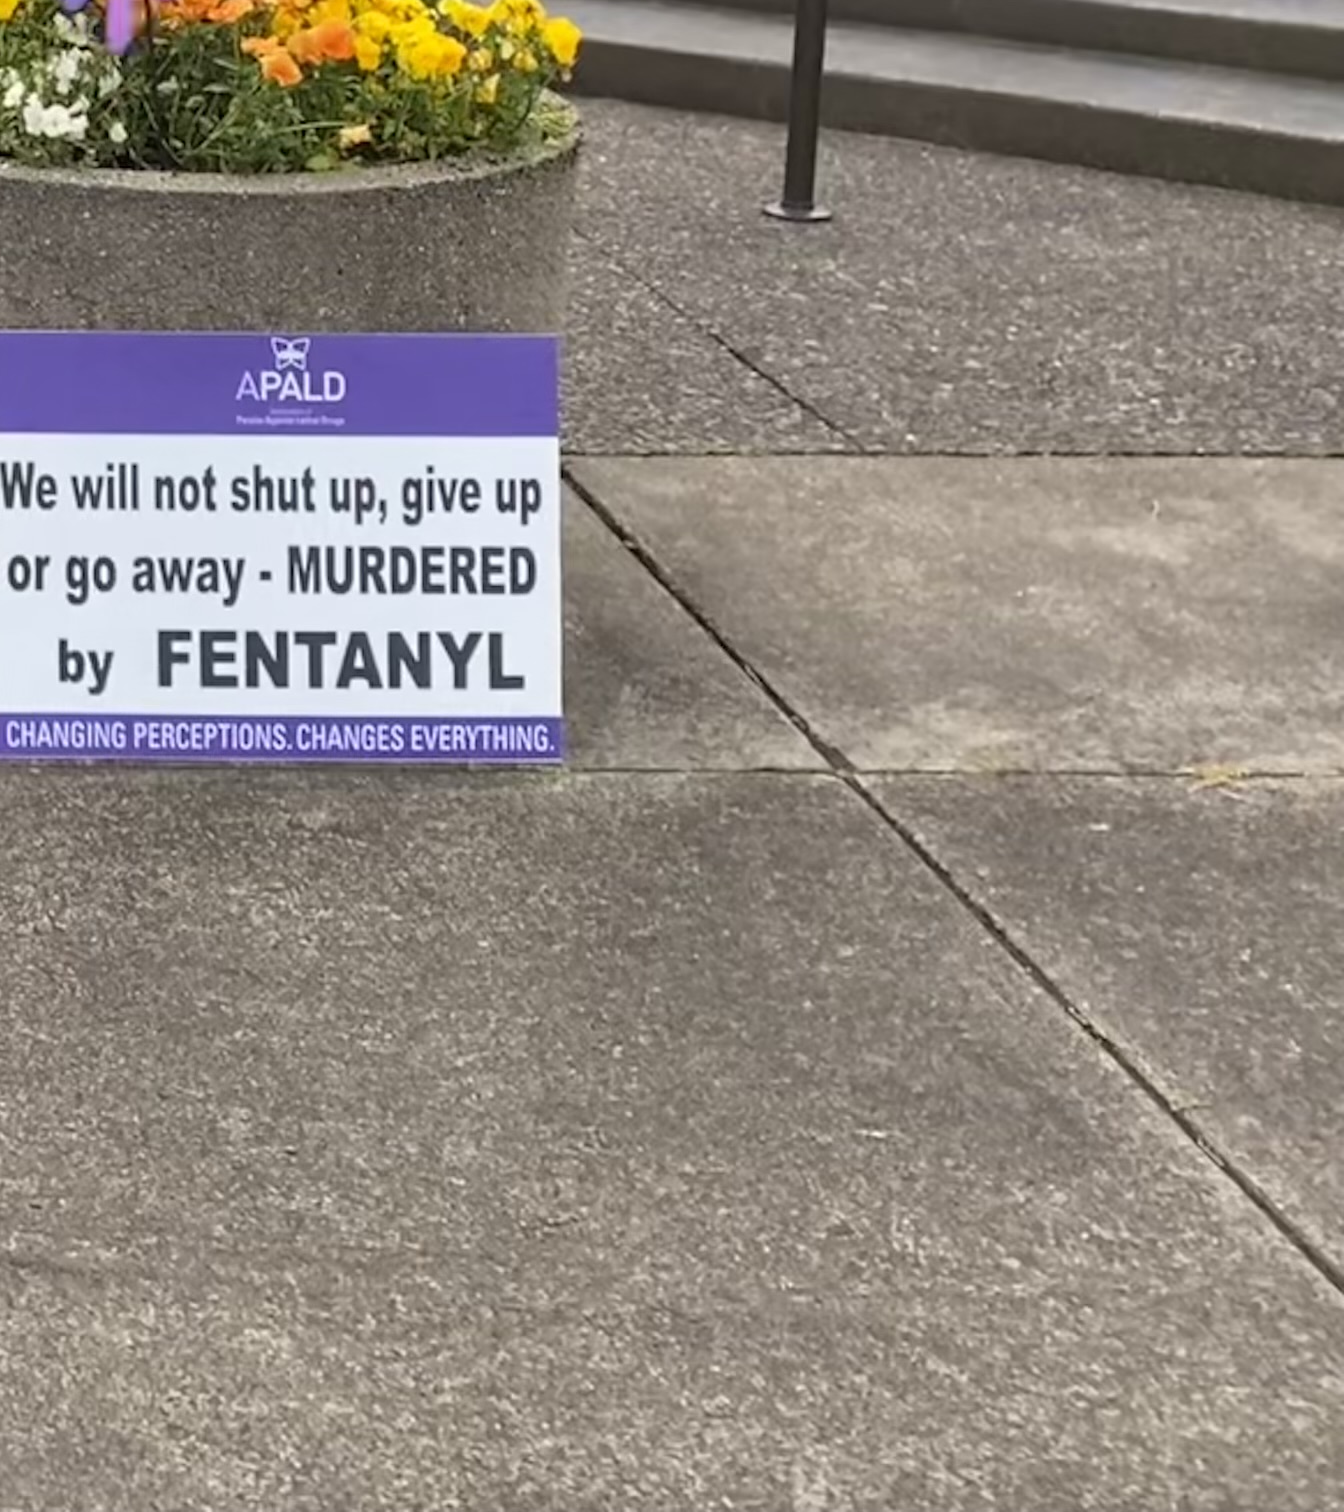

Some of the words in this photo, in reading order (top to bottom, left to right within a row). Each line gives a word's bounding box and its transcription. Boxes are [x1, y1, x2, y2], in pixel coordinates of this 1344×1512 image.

[235, 371, 346, 401] APALD
[0, 461, 57, 511] We
[71, 463, 139, 511] will
[155, 465, 217, 513] not
[230, 464, 315, 514] shut
[331, 474, 387, 525] up,
[402, 465, 481, 525] give
[496, 477, 542, 525] up
[7, 554, 50, 592] or
[65, 555, 116, 605] go
[132, 555, 245, 607] away
[288, 546, 537, 595] MURDERED
[58, 639, 114, 695] by
[157, 630, 525, 690] FENTANYL
[6, 720, 126, 751] CHANGING
[133, 721, 293, 751] PERCEPTIONS.
[297, 723, 404, 752] CHANGES
[412, 724, 556, 753] EVERYTHING.
